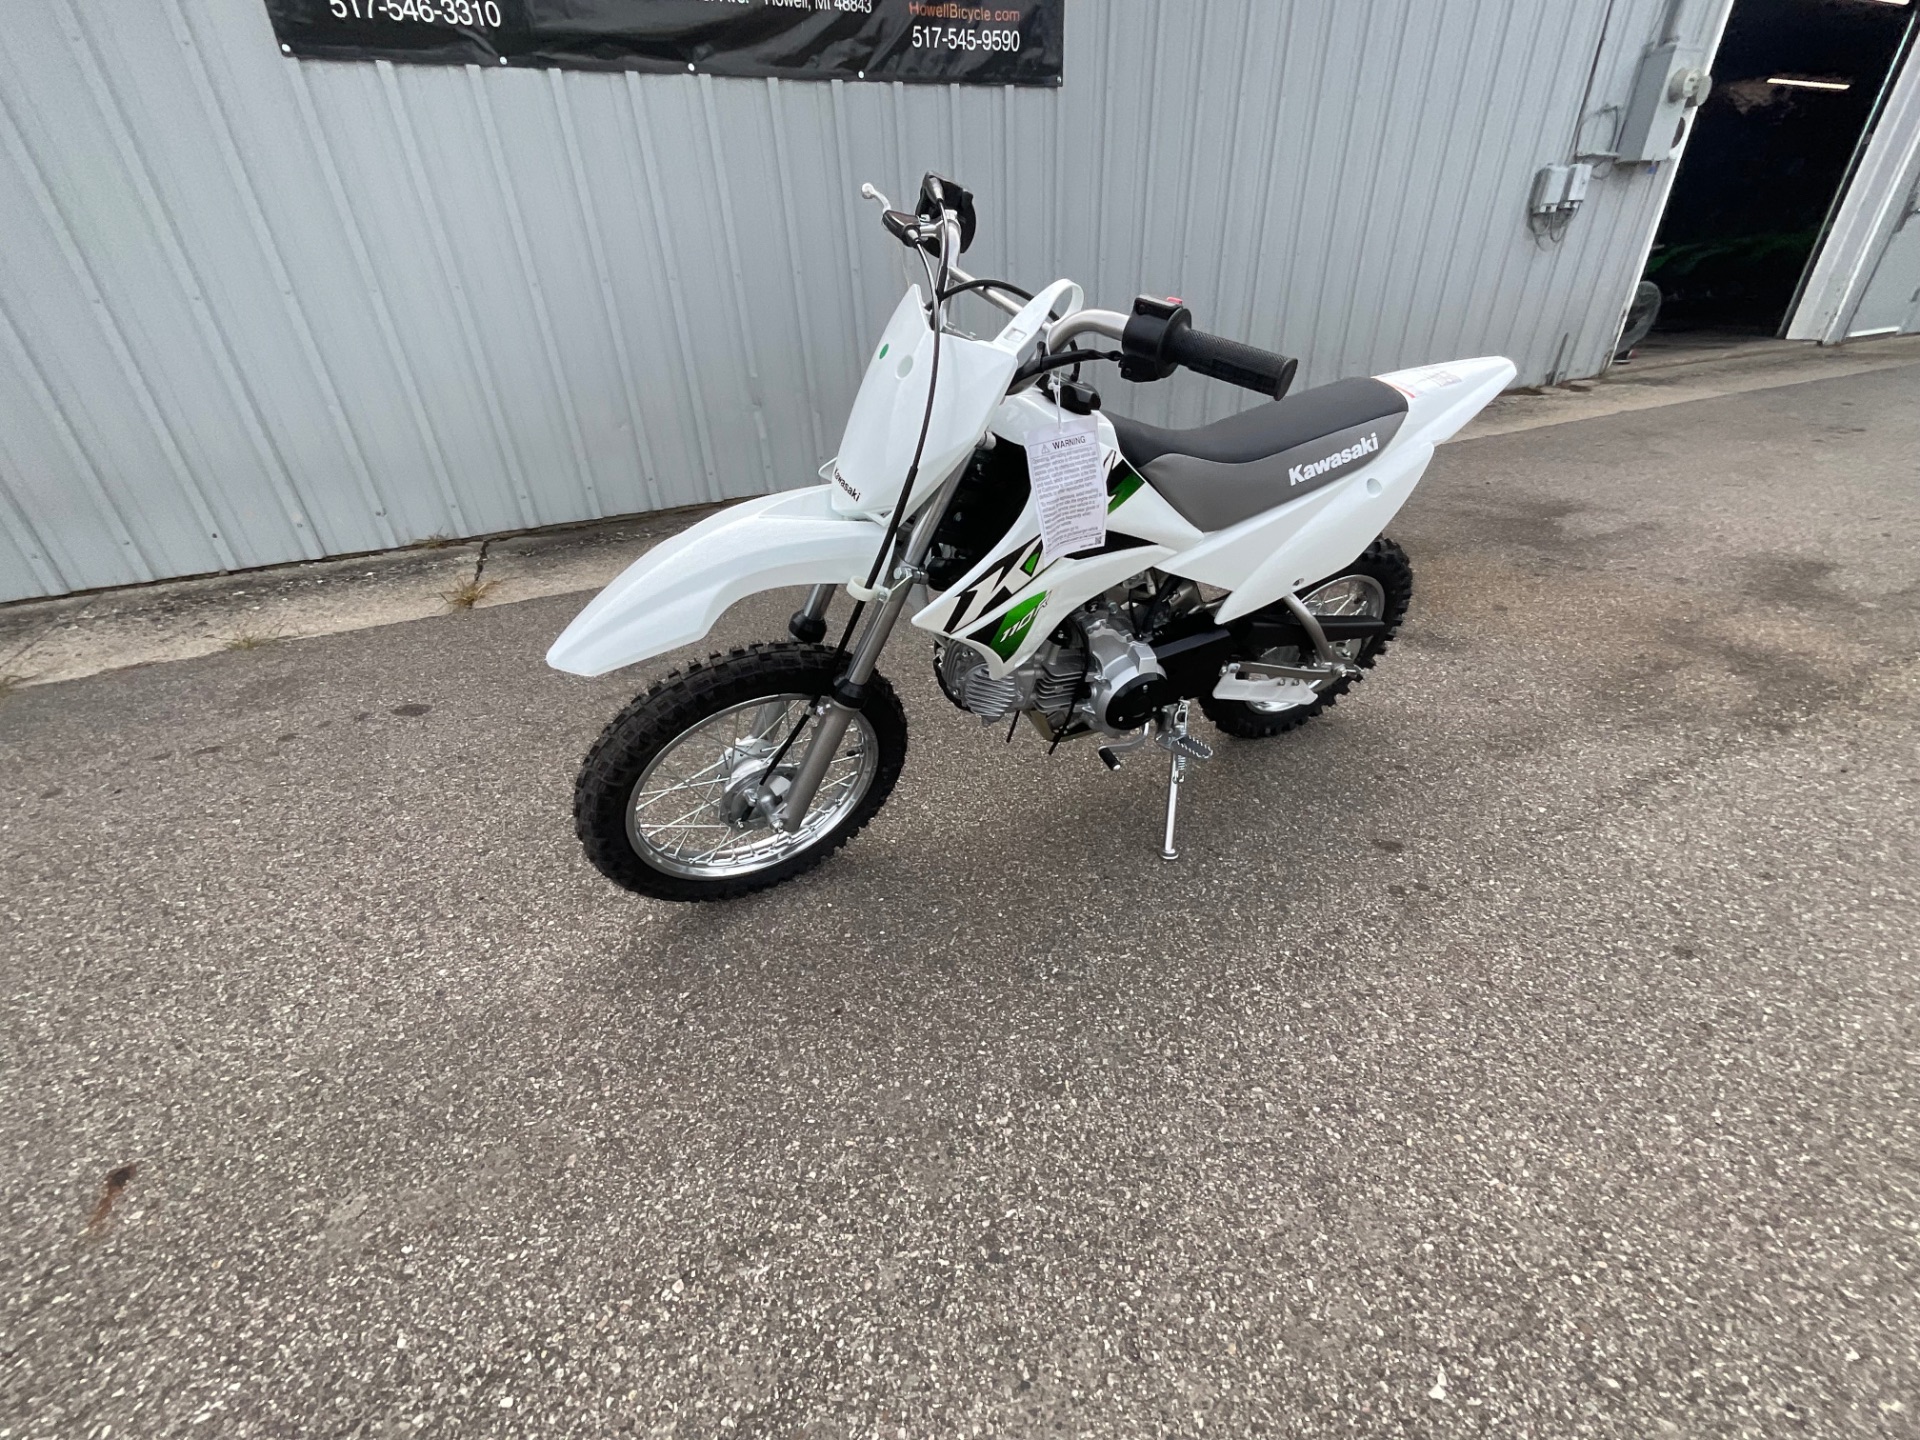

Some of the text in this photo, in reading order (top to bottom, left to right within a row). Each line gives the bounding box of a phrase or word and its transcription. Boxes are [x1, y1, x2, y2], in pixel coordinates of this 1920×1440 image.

[330, 0, 501, 27] 517-546-3310
[833, 0, 872, 13] 48843
[908, 2, 1020, 24] HowellBicycle.com
[911, 25, 1021, 52] 517-545-9590
[1051, 435, 1086, 450] WARNING
[1288, 431, 1379, 486] Kawasaki
